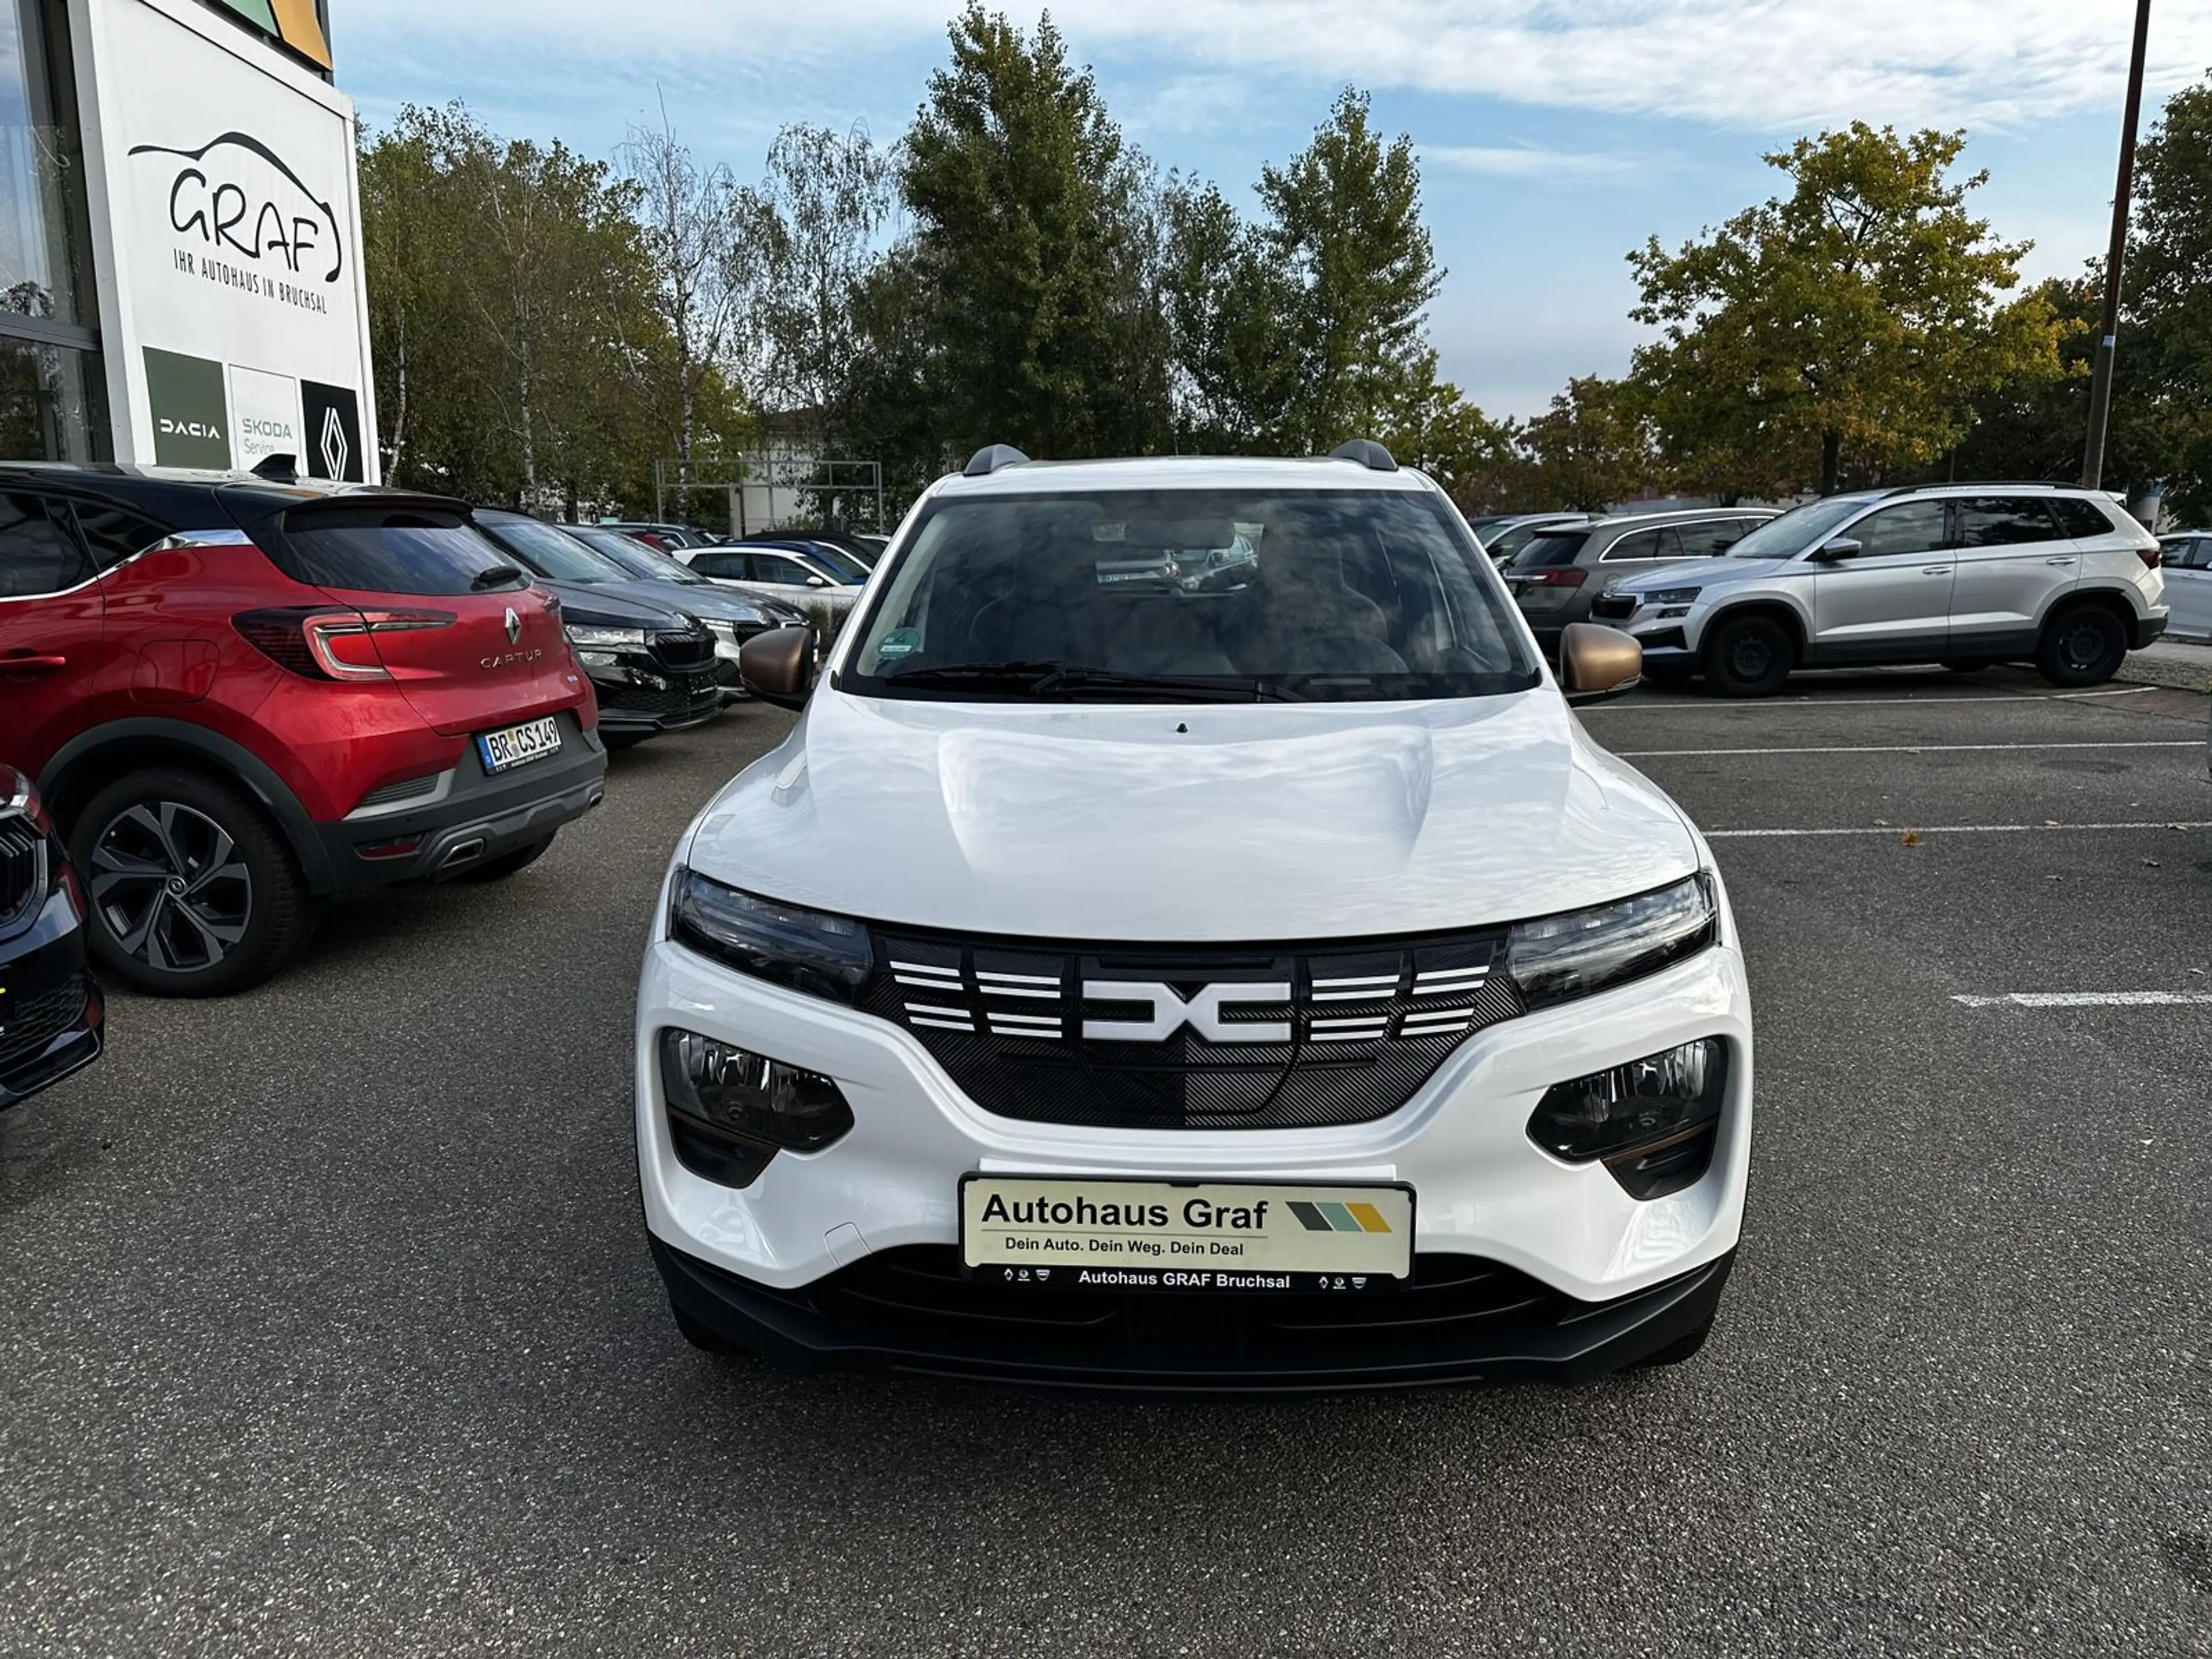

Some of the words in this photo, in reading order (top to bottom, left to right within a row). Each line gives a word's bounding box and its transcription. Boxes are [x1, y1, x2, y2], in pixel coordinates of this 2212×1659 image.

[170, 168, 319, 272] GRAF
[173, 248, 195, 275] IHR
[201, 257, 259, 294] AUTOHAUS
[263, 276, 274, 298] IN
[279, 282, 327, 315] BRUCHSAL
[160, 418, 221, 440] DACIA
[244, 438, 275, 455] Service
[480, 649, 541, 668] CAPTUR
[488, 734, 513, 762] BR
[982, 1194, 1169, 1227] Autohaus
[1183, 1199, 1269, 1229] Graf
[1006, 1237, 1039, 1249] Dein
[1043, 1238, 1084, 1251] Auto.
[1089, 1239, 1122, 1252] Dein
[1127, 1240, 1165, 1256] Weg.
[1171, 1241, 1205, 1254] Dein
[1210, 1242, 1243, 1255] Deal
[1078, 1270, 1158, 1285] Autohaus
[1162, 1272, 1211, 1287] GRAF
[1216, 1274, 1290, 1289] Bruchsal
